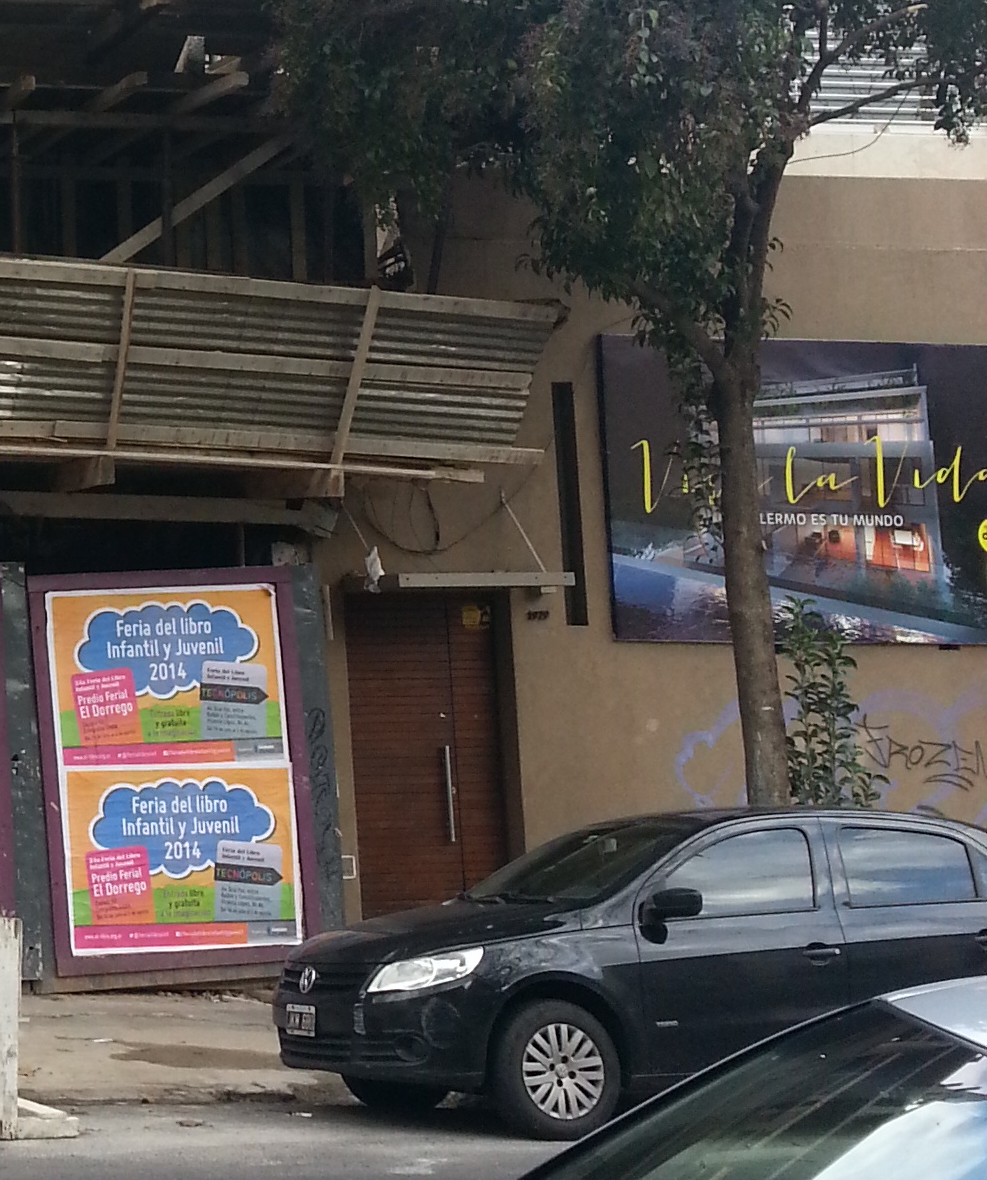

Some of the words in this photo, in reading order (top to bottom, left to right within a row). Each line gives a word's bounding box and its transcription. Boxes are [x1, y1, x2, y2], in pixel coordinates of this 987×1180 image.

[811, 513, 827, 527] ES
[831, 514, 849, 527] TU
[854, 514, 904, 527] MUNDO
[117, 620, 150, 637] Feria
[156, 619, 177, 636] del
[181, 619, 211, 635] libro
[107, 640, 159, 659] Infantil
[163, 644, 171, 661] y
[176, 638, 224, 657] Juvenil
[150, 663, 187, 681] 2014
[132, 796, 165, 814] Feria
[171, 796, 192, 813] del
[196, 796, 227, 813] libro
[122, 818, 175, 836] Infantil
[179, 822, 186, 838] y
[191, 816, 239, 835] Juvenil
[165, 841, 201, 860] 2014
[93, 883, 104, 897] El
[106, 881, 146, 897] Dorrego
